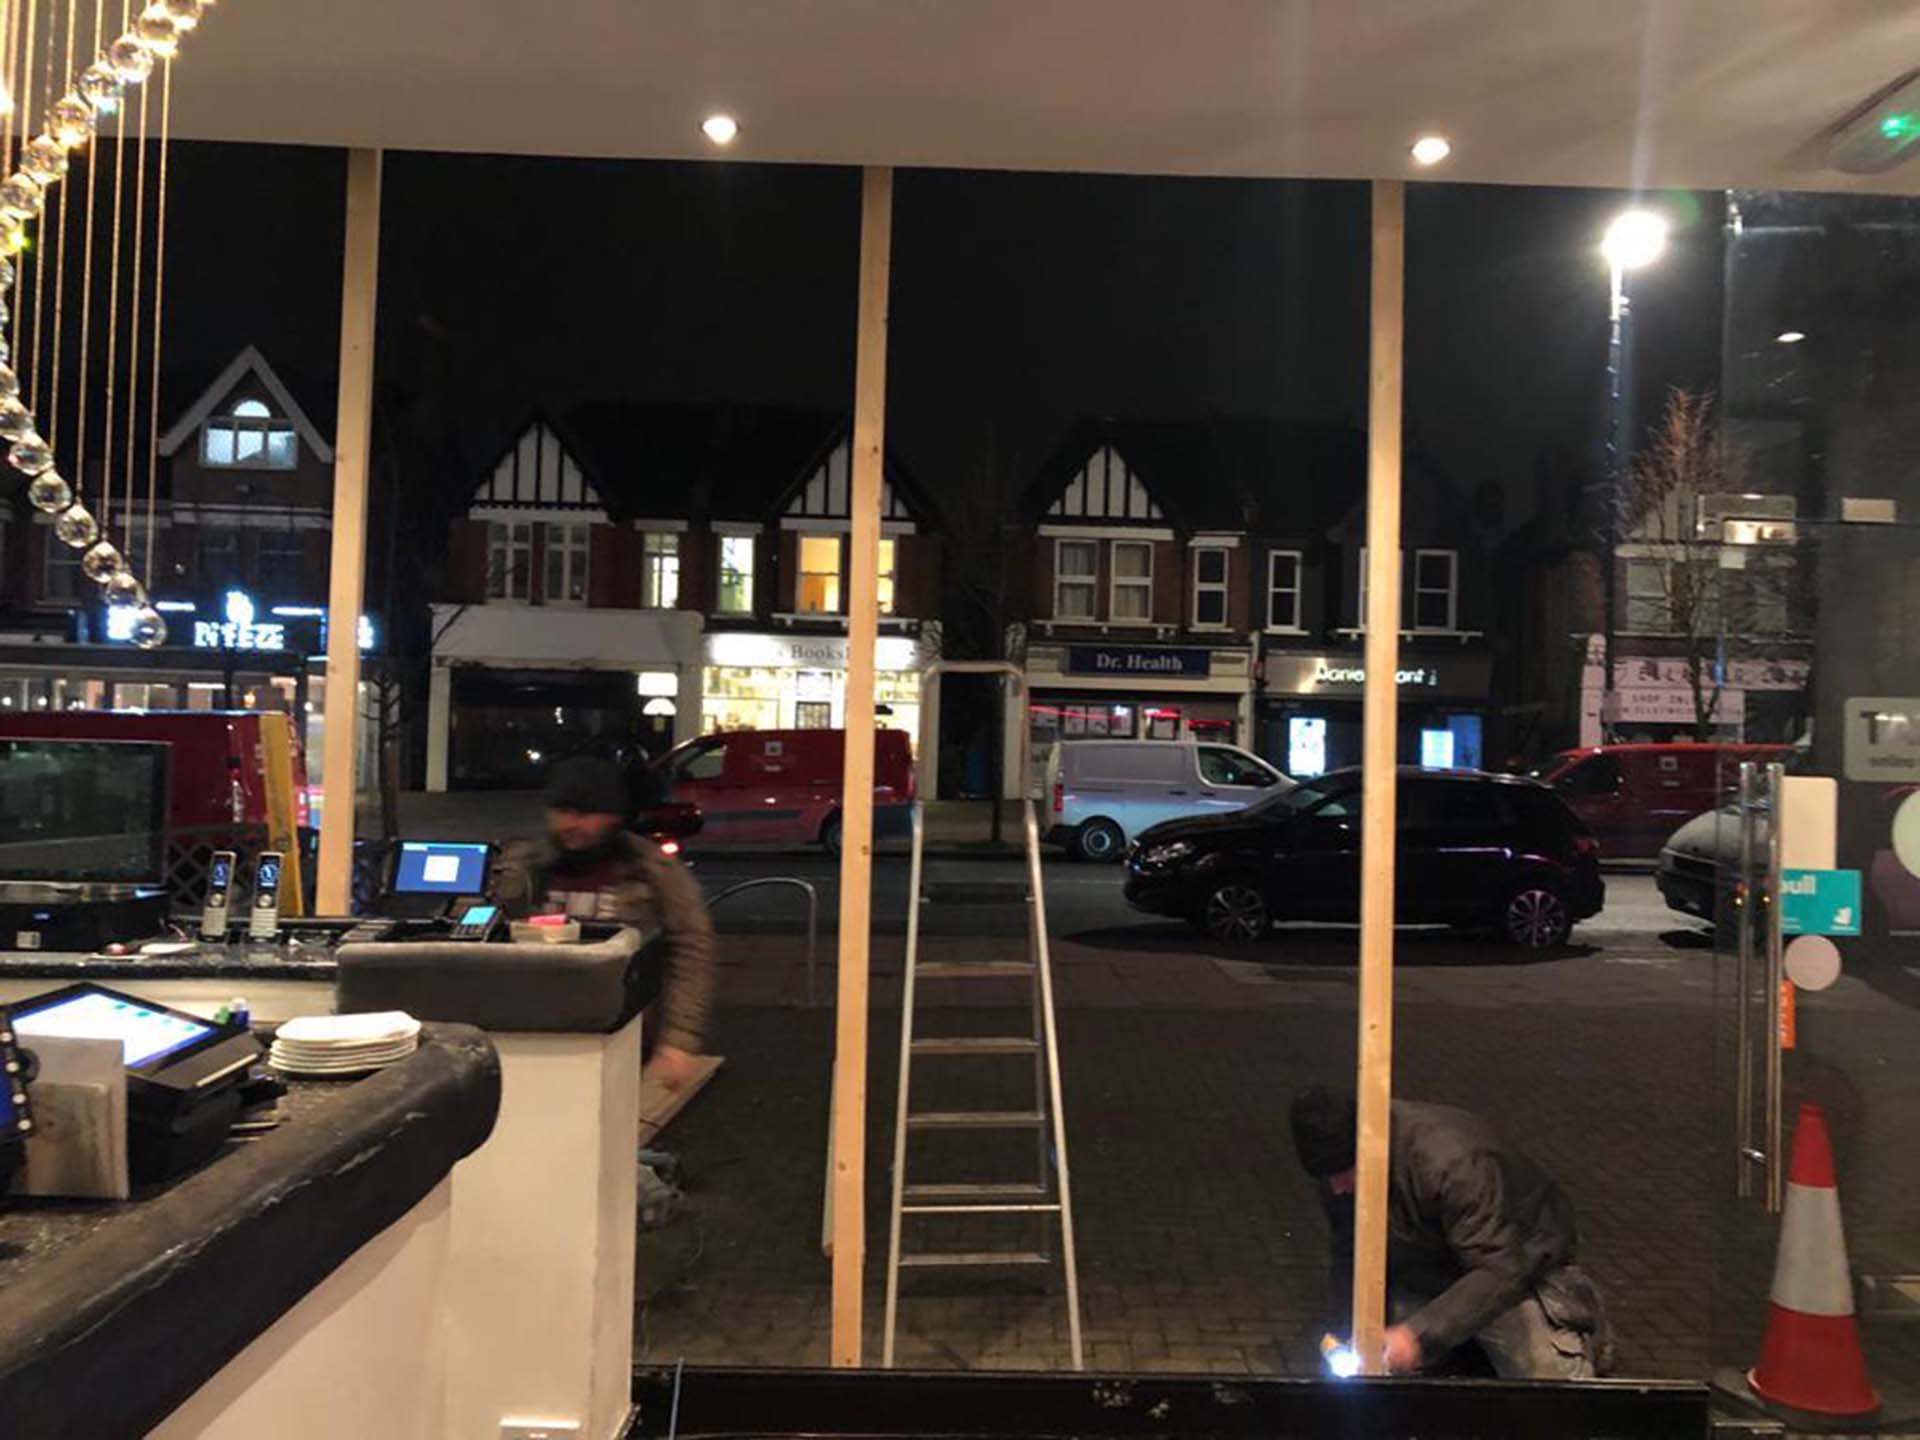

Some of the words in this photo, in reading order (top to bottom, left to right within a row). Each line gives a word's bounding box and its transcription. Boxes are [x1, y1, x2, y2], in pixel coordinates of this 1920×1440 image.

[791, 643, 850, 660] Books
[1096, 652, 1121, 669] Dr.
[1126, 653, 1183, 672] Health
